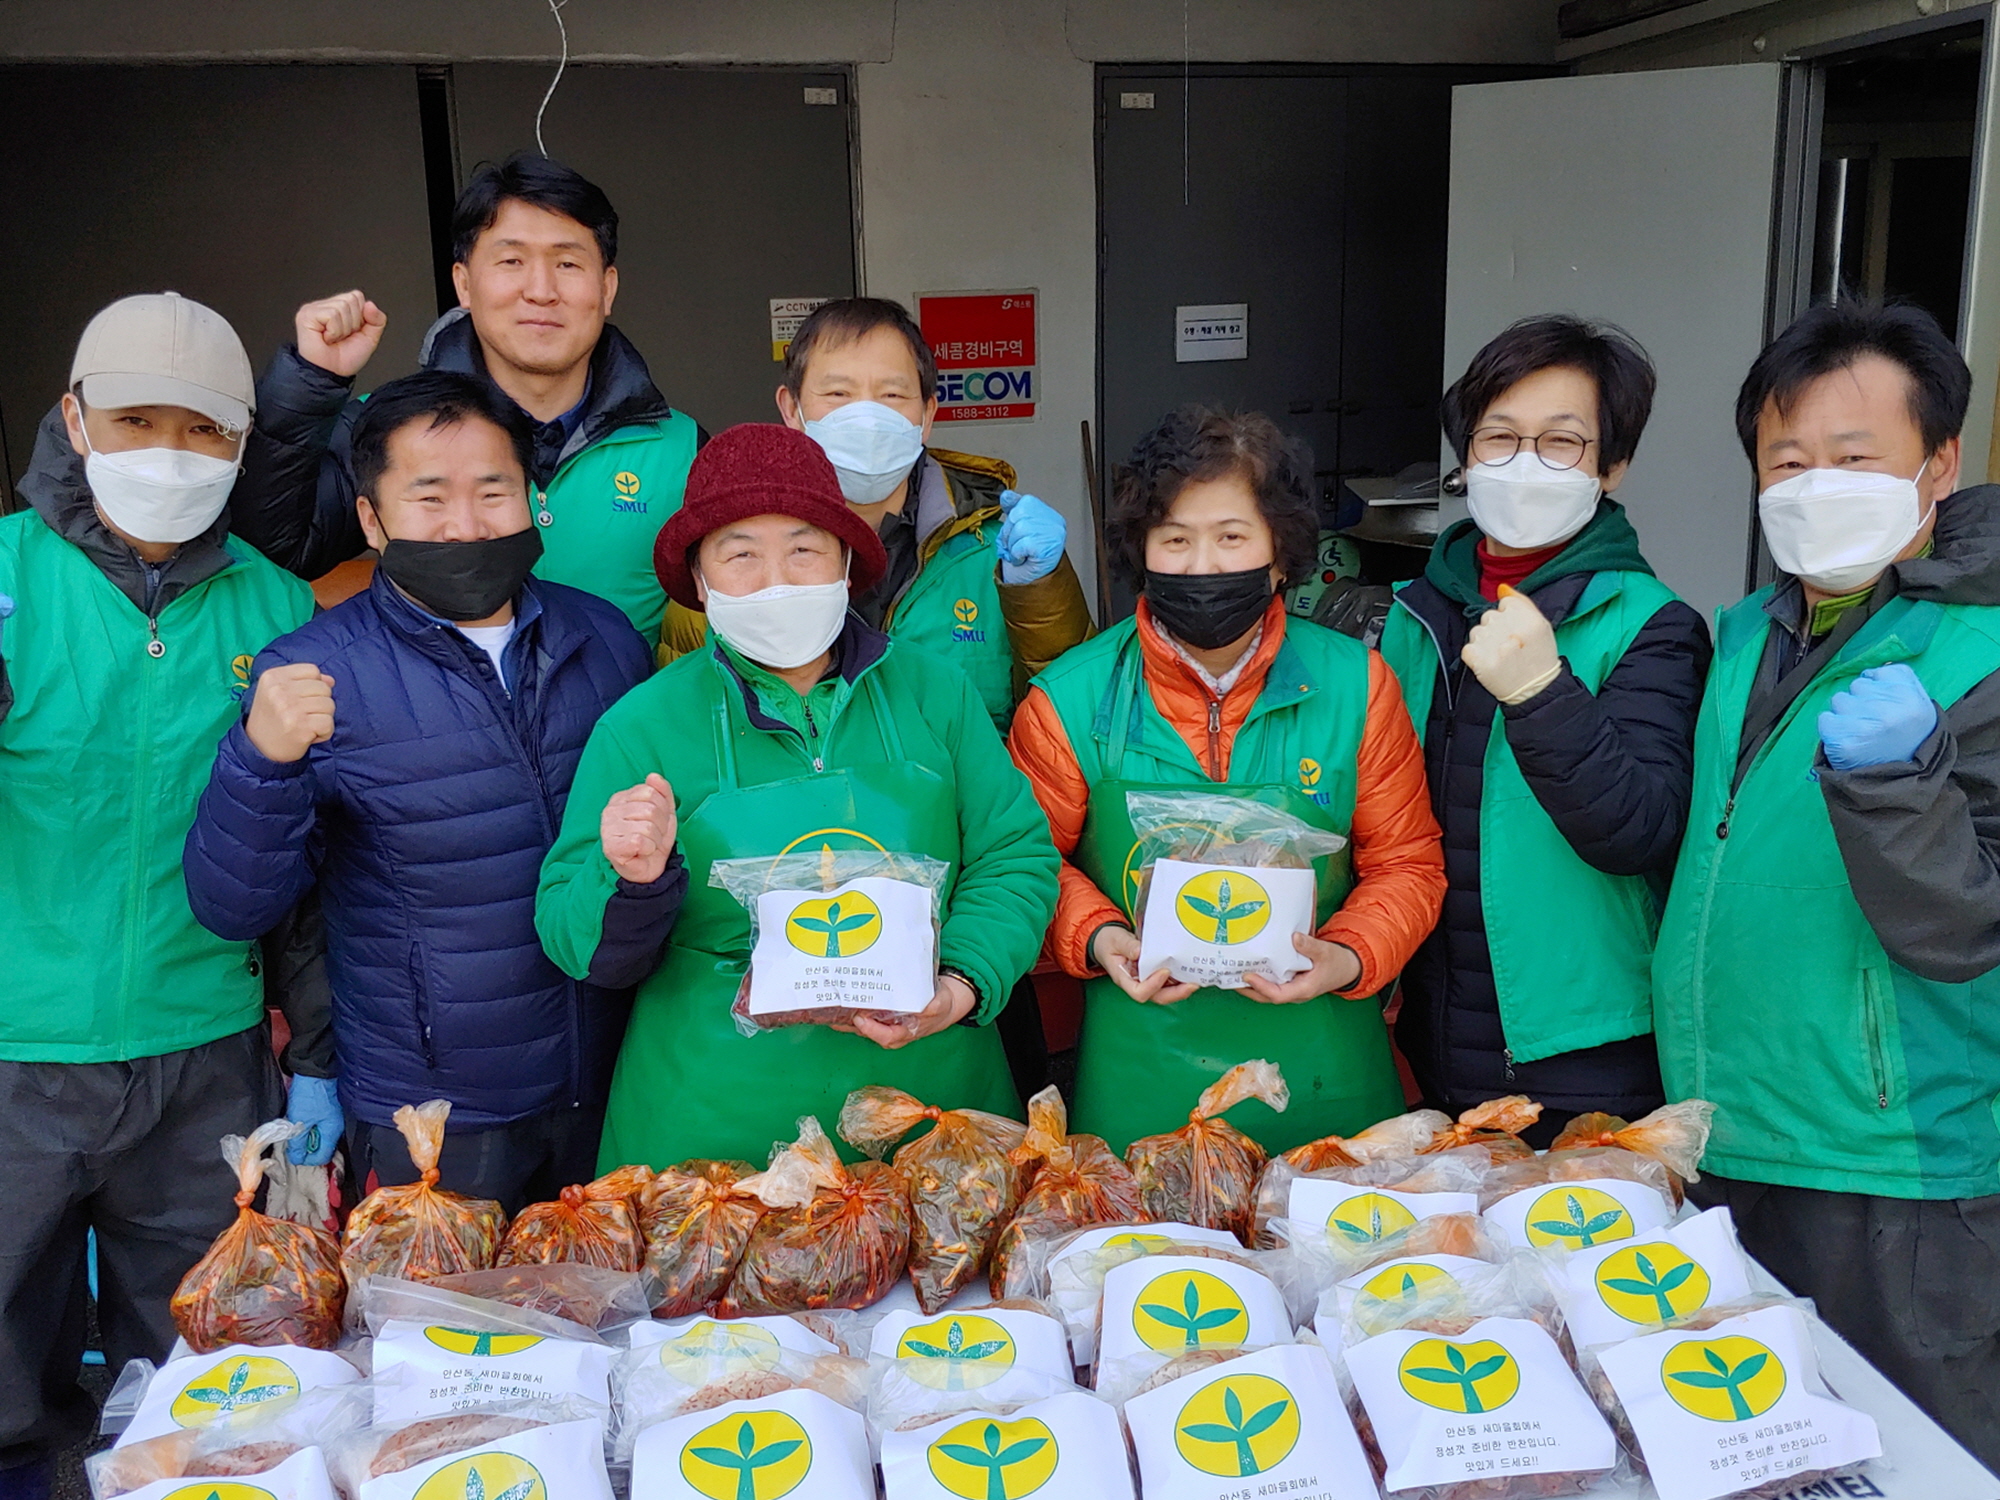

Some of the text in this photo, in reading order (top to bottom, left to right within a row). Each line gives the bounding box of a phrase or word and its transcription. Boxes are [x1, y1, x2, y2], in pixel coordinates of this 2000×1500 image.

[934, 340, 1023, 360] 세콤경비구역
[937, 371, 1031, 402] SECOM
[951, 406, 1009, 419] 1588-3112
[612, 500, 647, 514] SMU
[952, 629, 986, 643] SMU
[804, 966, 884, 977] 안산동 새마을회에서
[823, 979, 847, 988] 준비한
[816, 992, 840, 1002] 맛있게
[443, 1369, 543, 1384] 안산동 새마을회에서
[463, 1382, 493, 1394] 준비한
[1445, 1421, 1542, 1438] 안산동 새마을회에서
[1717, 1418, 1813, 1449] 안산동 새마을회에서
[1436, 1436, 1560, 1458] 정성껏 준비한 반찬입니다.
[1709, 1433, 1831, 1471] 정성껏 준비한 반찬입니다.
[1465, 1456, 1539, 1472] 맛있게 드세요!!
[1740, 1455, 1809, 1482] 맛있게 드세요!!
[1258, 1475, 1318, 1497] 새마을회에서
